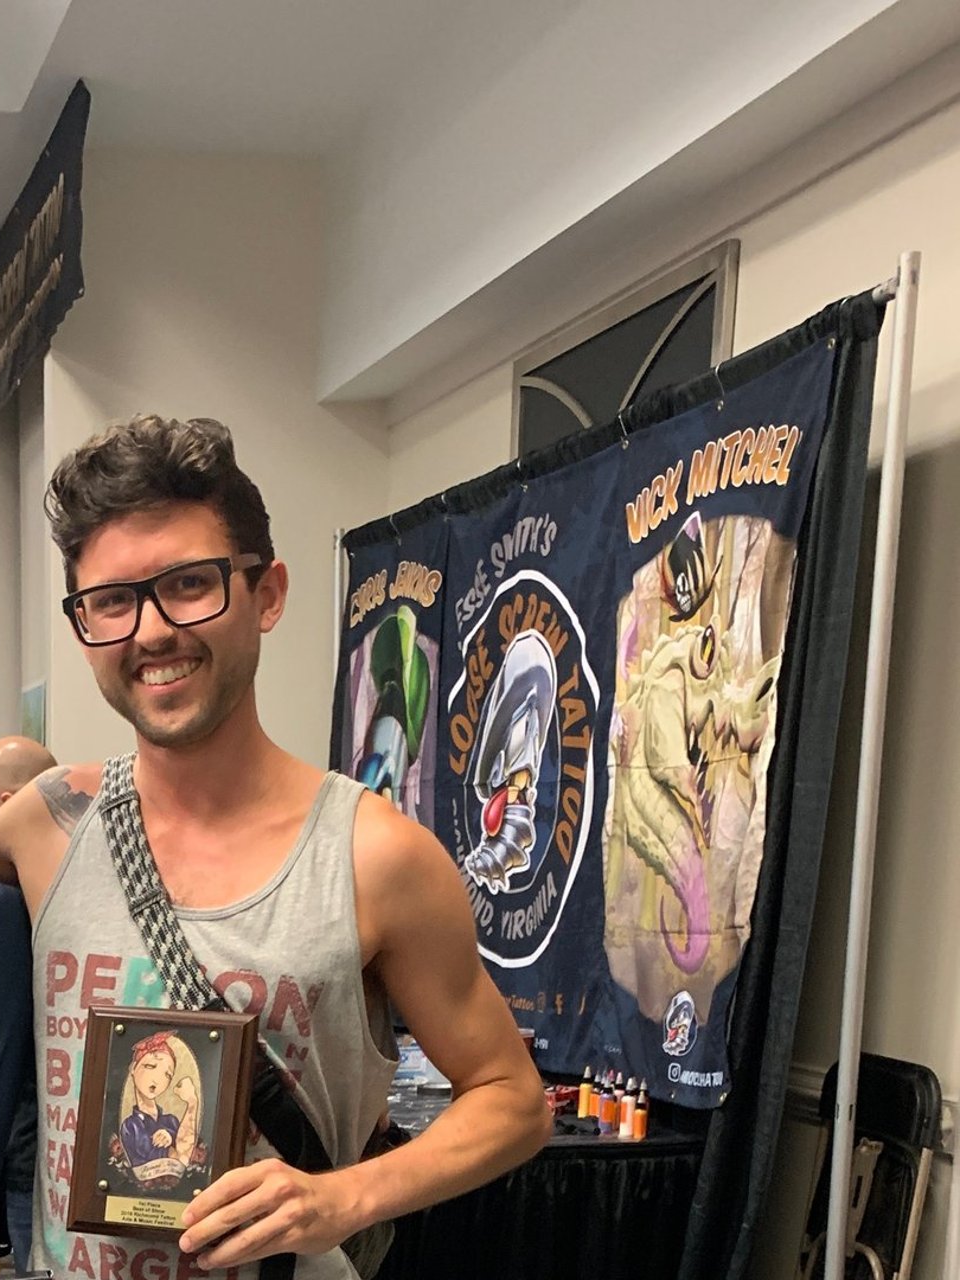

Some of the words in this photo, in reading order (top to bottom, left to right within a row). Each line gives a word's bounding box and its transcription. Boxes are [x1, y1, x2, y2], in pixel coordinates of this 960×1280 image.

[685, 424, 804, 506] MITCHEL
[449, 628, 494, 775] LOOSE
[499, 593, 569, 658] SCREW
[501, 871, 558, 940] VIRGINIA
[46, 950, 325, 1037] PERON
